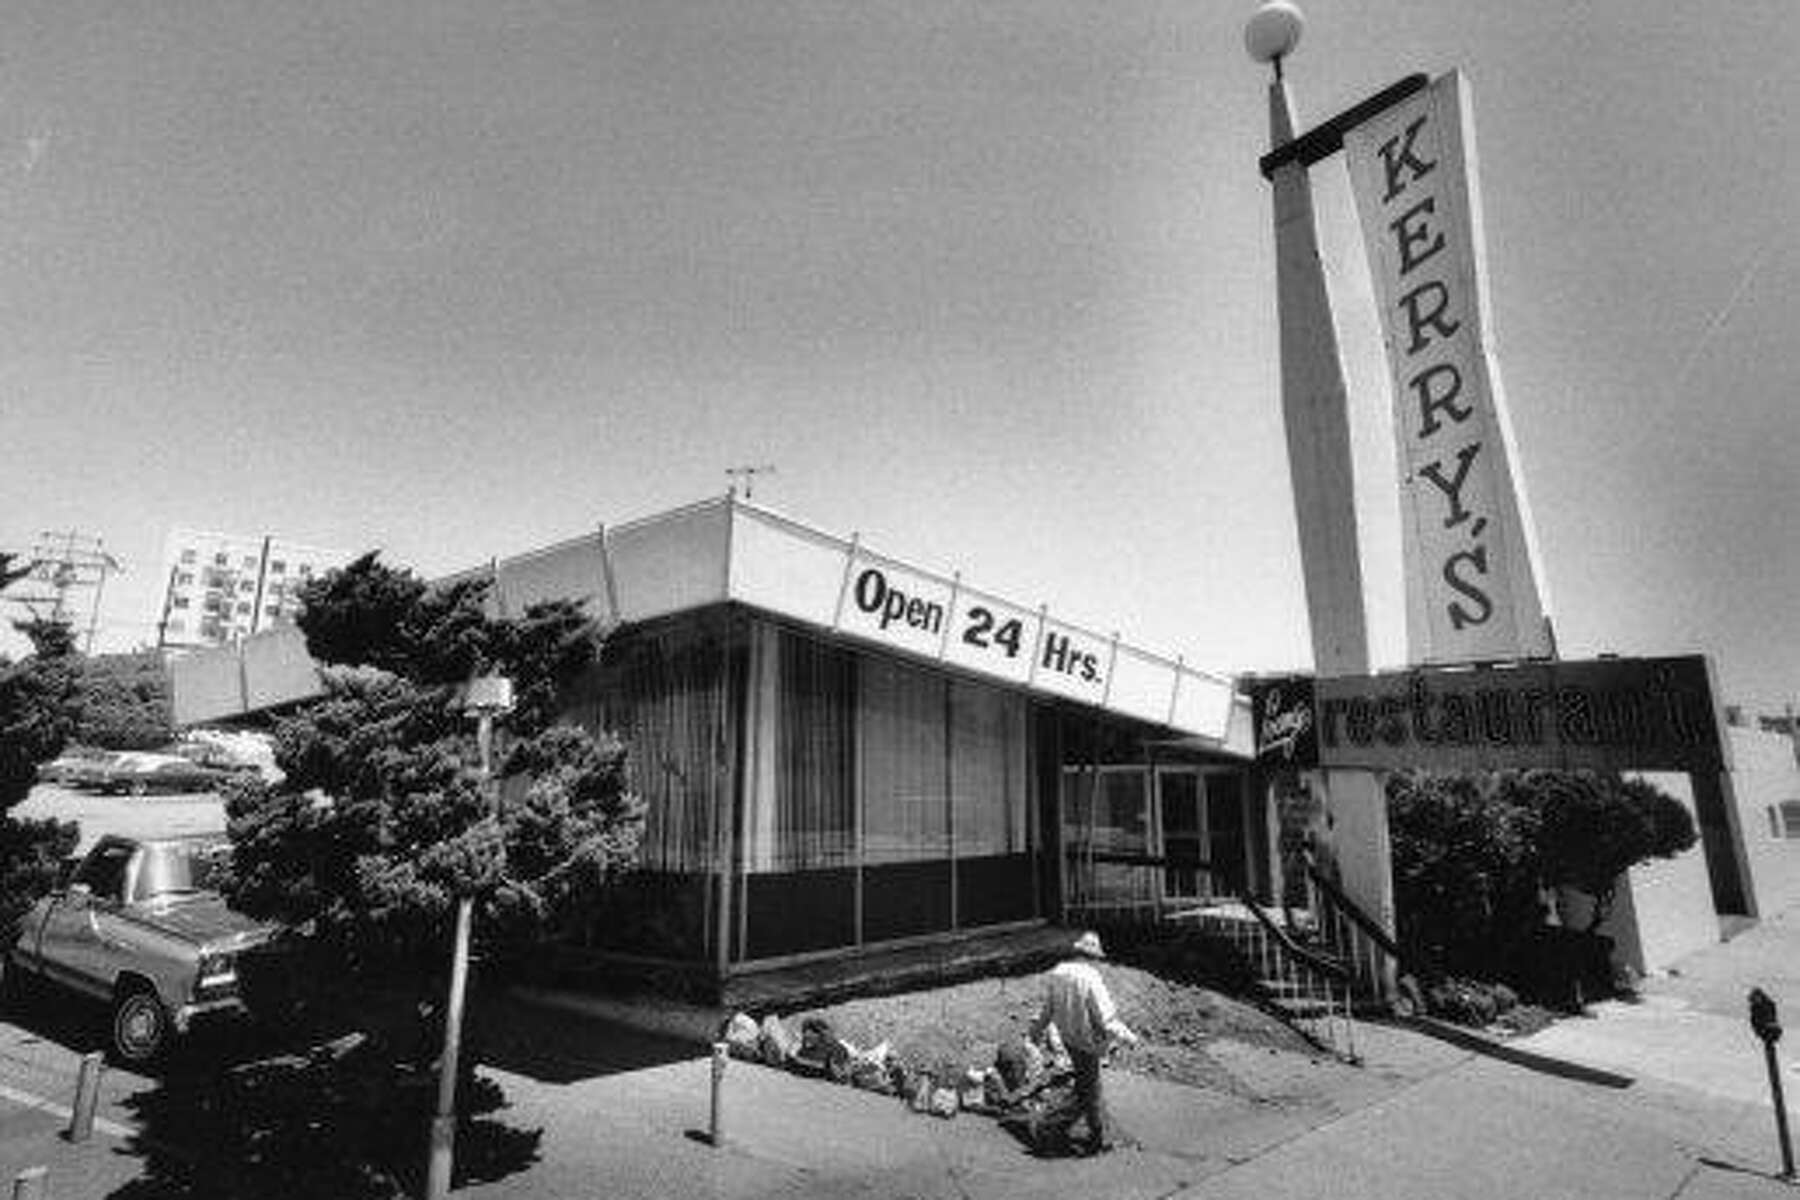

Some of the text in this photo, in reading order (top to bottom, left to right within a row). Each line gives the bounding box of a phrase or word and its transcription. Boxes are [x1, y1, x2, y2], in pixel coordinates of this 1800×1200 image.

[1376, 115, 1493, 630] KERRY'S
[855, 569, 1103, 683] Open 24 Hrs.
